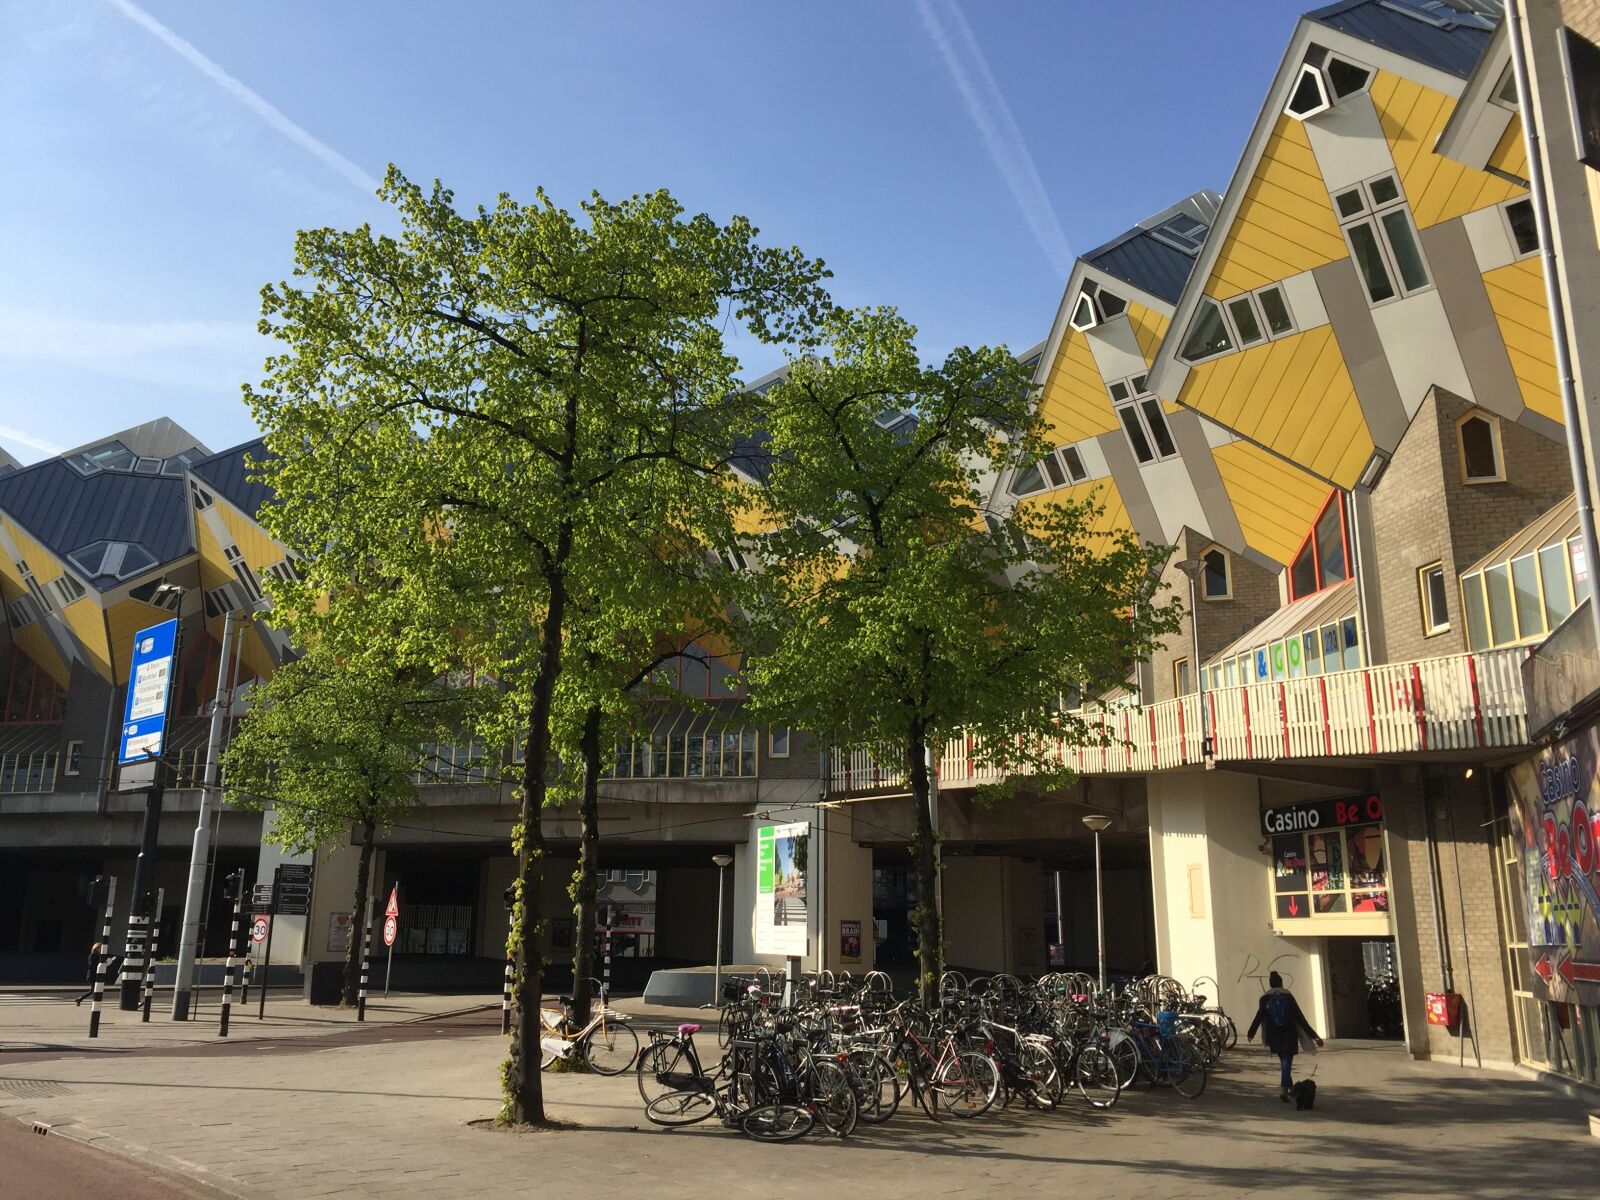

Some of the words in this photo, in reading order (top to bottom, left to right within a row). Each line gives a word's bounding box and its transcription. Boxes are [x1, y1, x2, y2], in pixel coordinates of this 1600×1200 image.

[1539, 756, 1581, 804] Casino
[1264, 806, 1320, 833] Casino
[1335, 802, 1359, 825] Be
[1543, 811, 1572, 880] Be
[254, 925, 266, 935] 30
